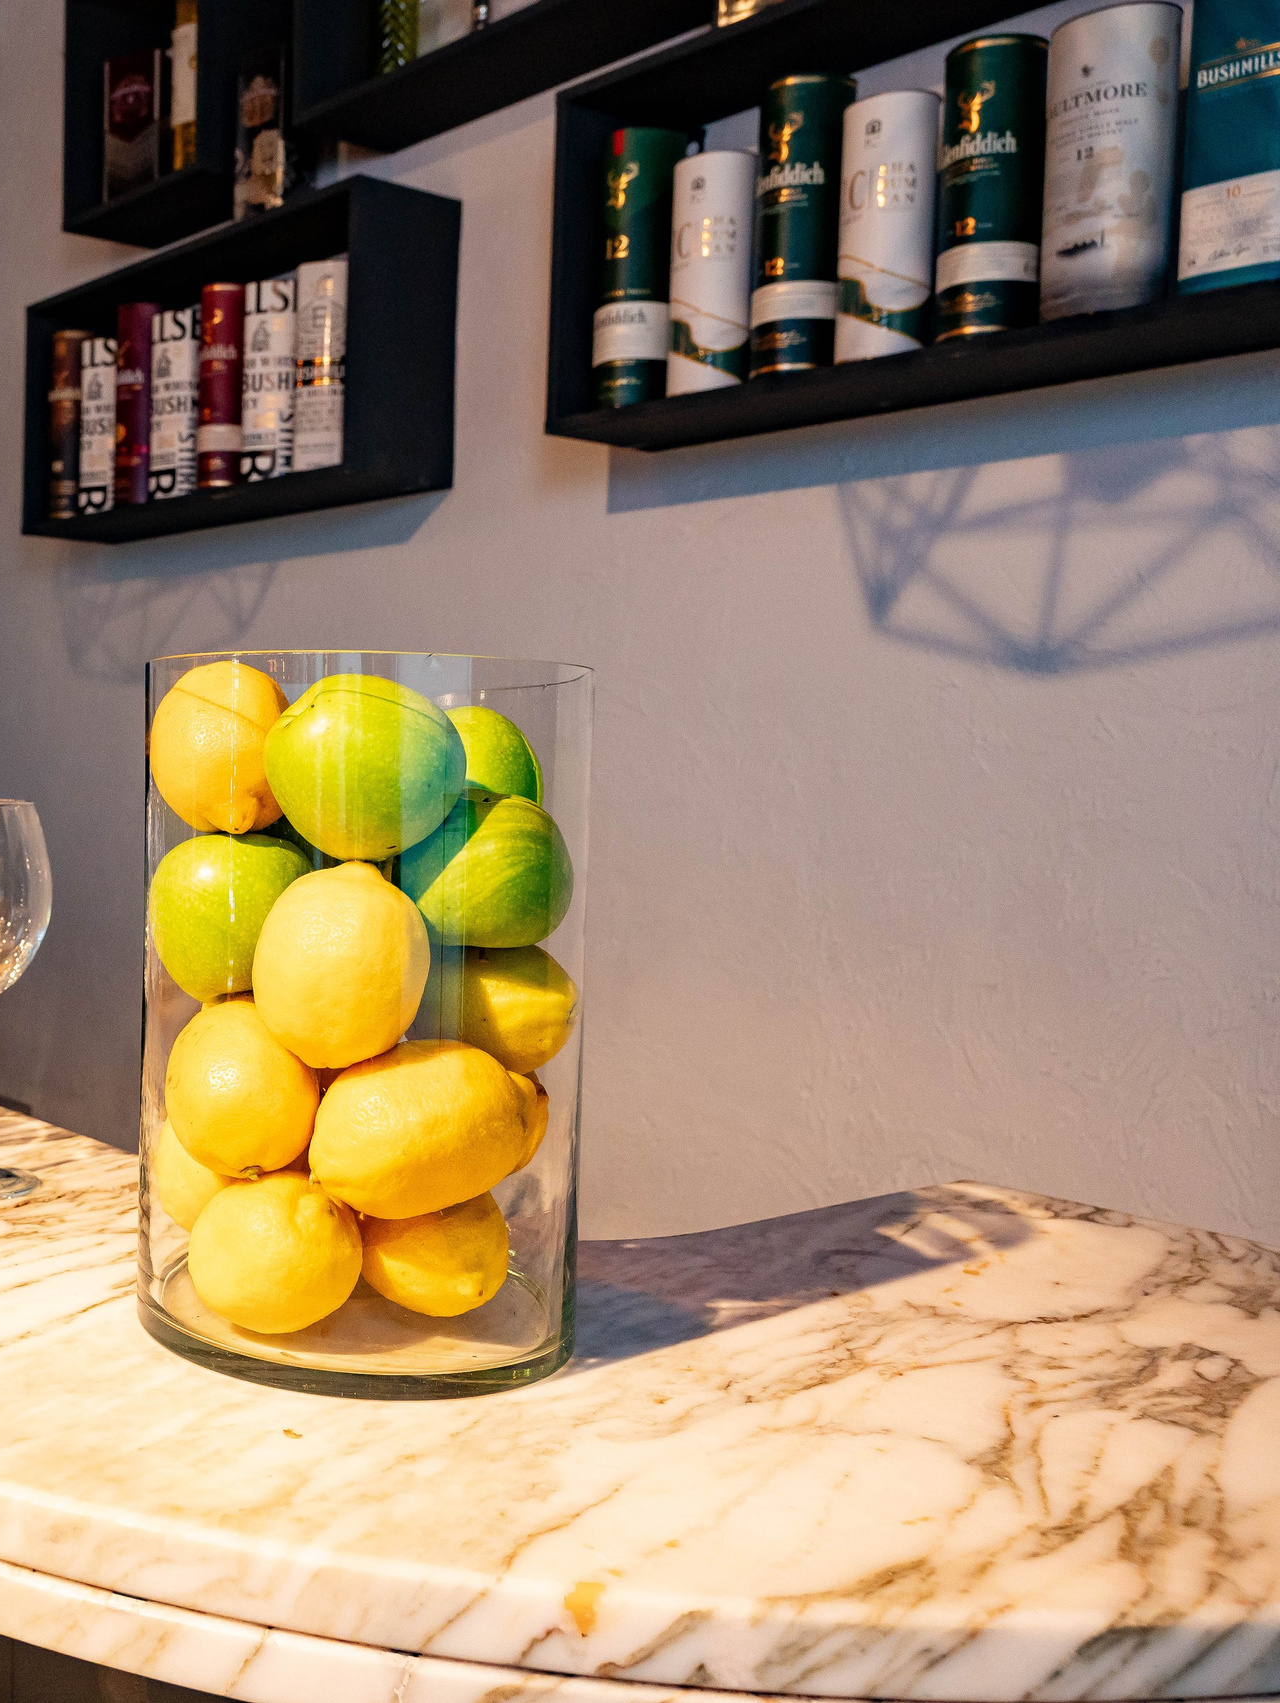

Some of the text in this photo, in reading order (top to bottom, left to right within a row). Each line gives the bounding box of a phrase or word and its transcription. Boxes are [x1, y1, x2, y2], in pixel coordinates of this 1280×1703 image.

[1048, 81, 1148, 119] ULTMORE
[1076, 145, 1094, 160] 12
[606, 234, 630, 260] 12
